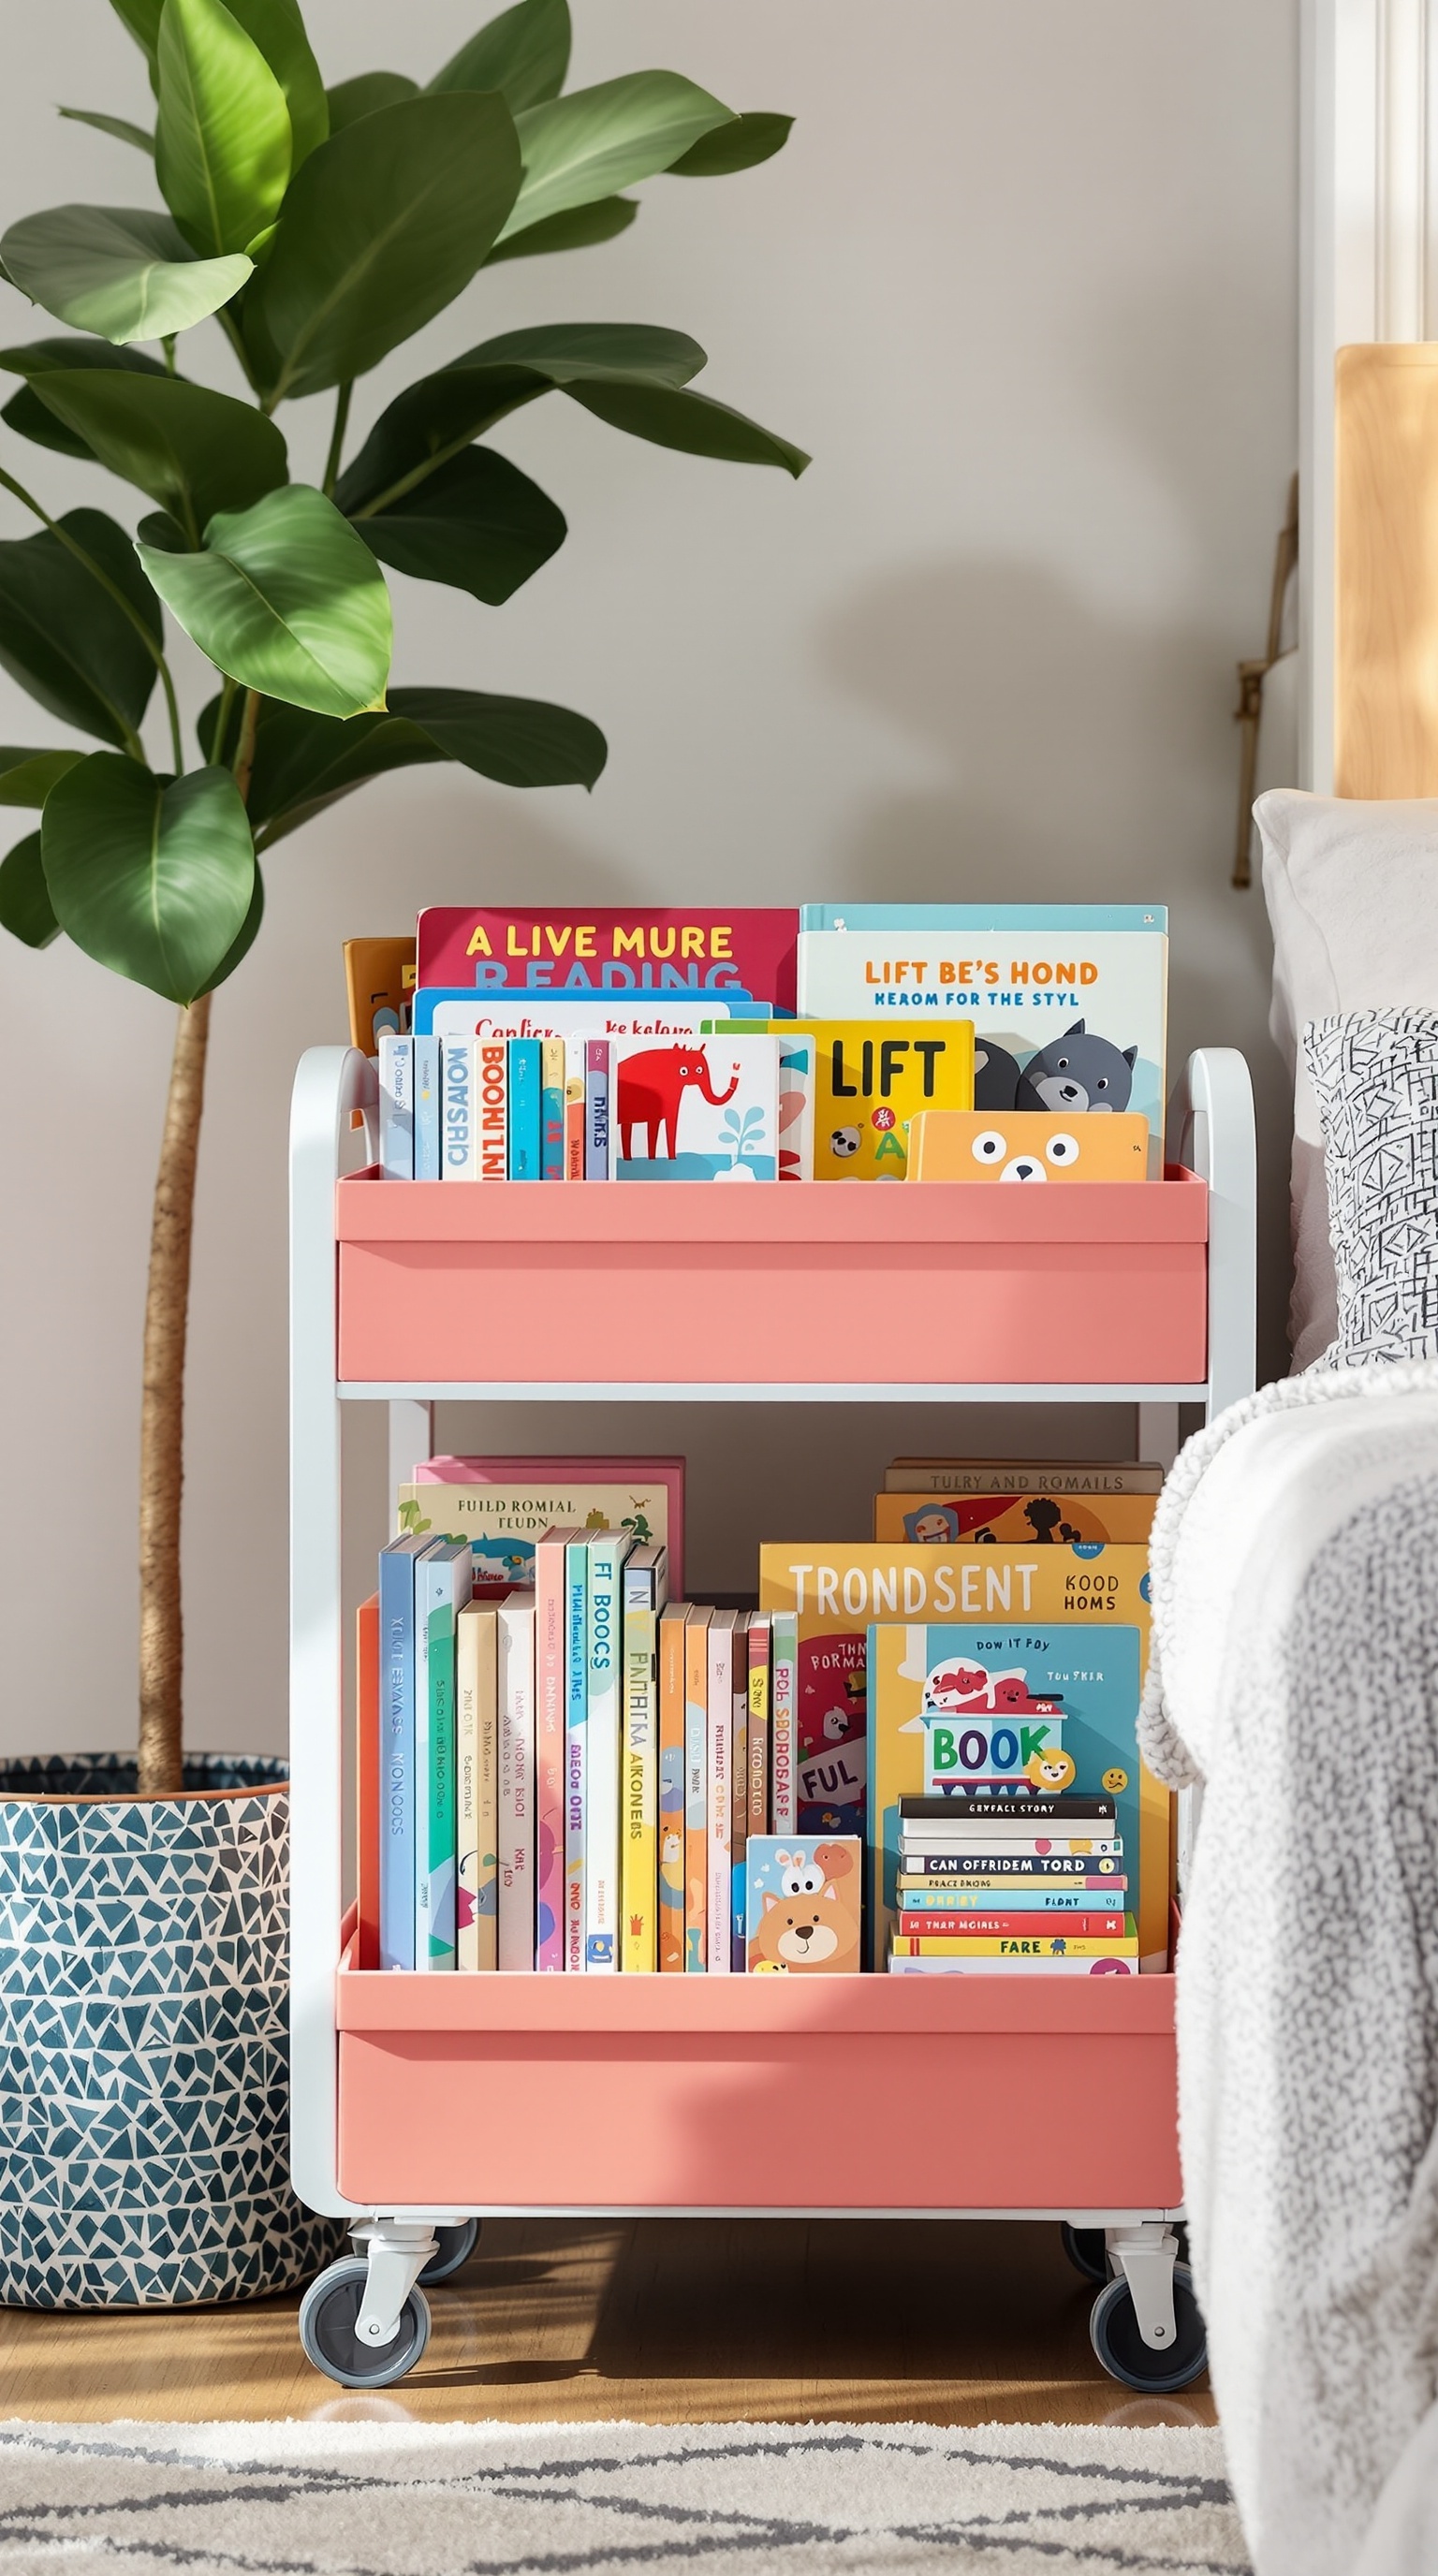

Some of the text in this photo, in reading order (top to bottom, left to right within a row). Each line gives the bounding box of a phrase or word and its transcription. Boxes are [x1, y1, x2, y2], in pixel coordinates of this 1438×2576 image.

[466, 925, 733, 959] A LIVE MURE
[865, 959, 1098, 985] LIFT BE'S HOND
[946, 992, 980, 1006] FOR
[988, 992, 1023, 1006] THE
[1032, 992, 1079, 1006] STYL
[830, 1039, 946, 1098] LIFT
[930, 1475, 1124, 1490] TULRY AND ROMAILS
[1065, 1574, 1120, 1592] KOOD
[1064, 1596, 1117, 1611] HOMS
[976, 1641, 1003, 1651] DOW
[1008, 1637, 1021, 1648] IT
[932, 1724, 1051, 1771] BOOK
[801, 1759, 859, 1799] FUL
[1020, 1804, 1055, 1813] STORY
[930, 1859, 958, 1871] CAN
[1041, 1859, 1085, 1872] TORD
[1000, 1940, 1041, 1954] FARE
